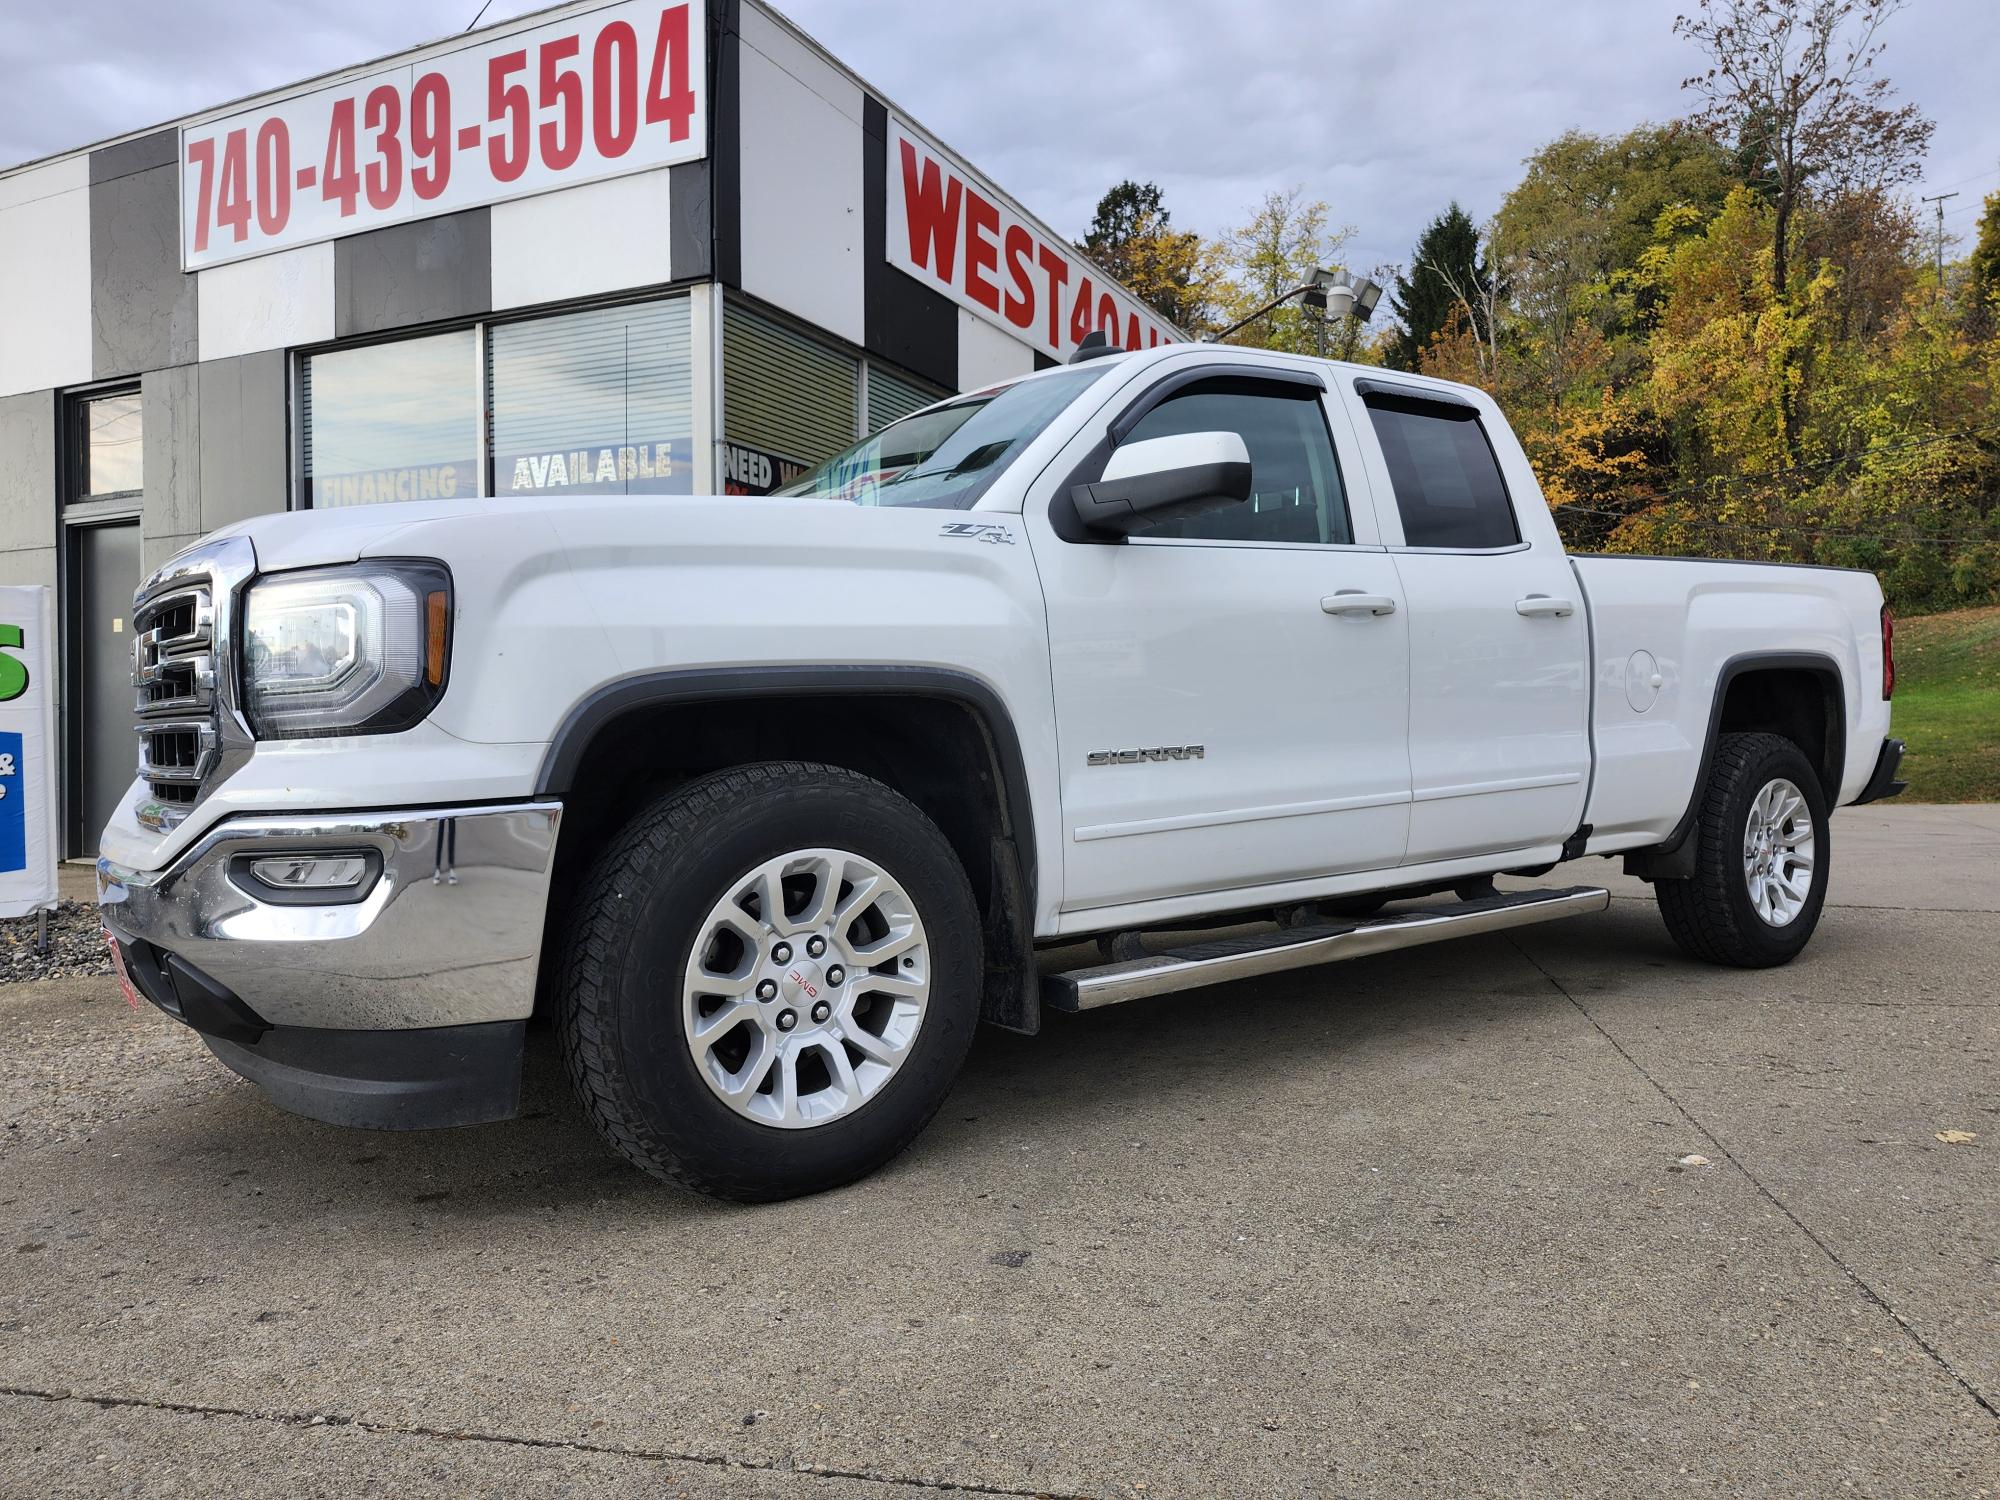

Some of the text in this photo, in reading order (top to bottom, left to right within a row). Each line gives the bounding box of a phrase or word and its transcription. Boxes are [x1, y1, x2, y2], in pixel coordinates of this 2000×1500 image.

[188, 3, 696, 253] 740-439-5504
[321, 464, 457, 508] FINANCING
[511, 442, 672, 490] AVAILABLE
[724, 444, 773, 489] NEED
[1086, 744, 1205, 767] SIERRA
[789, 969, 818, 999] GMC
